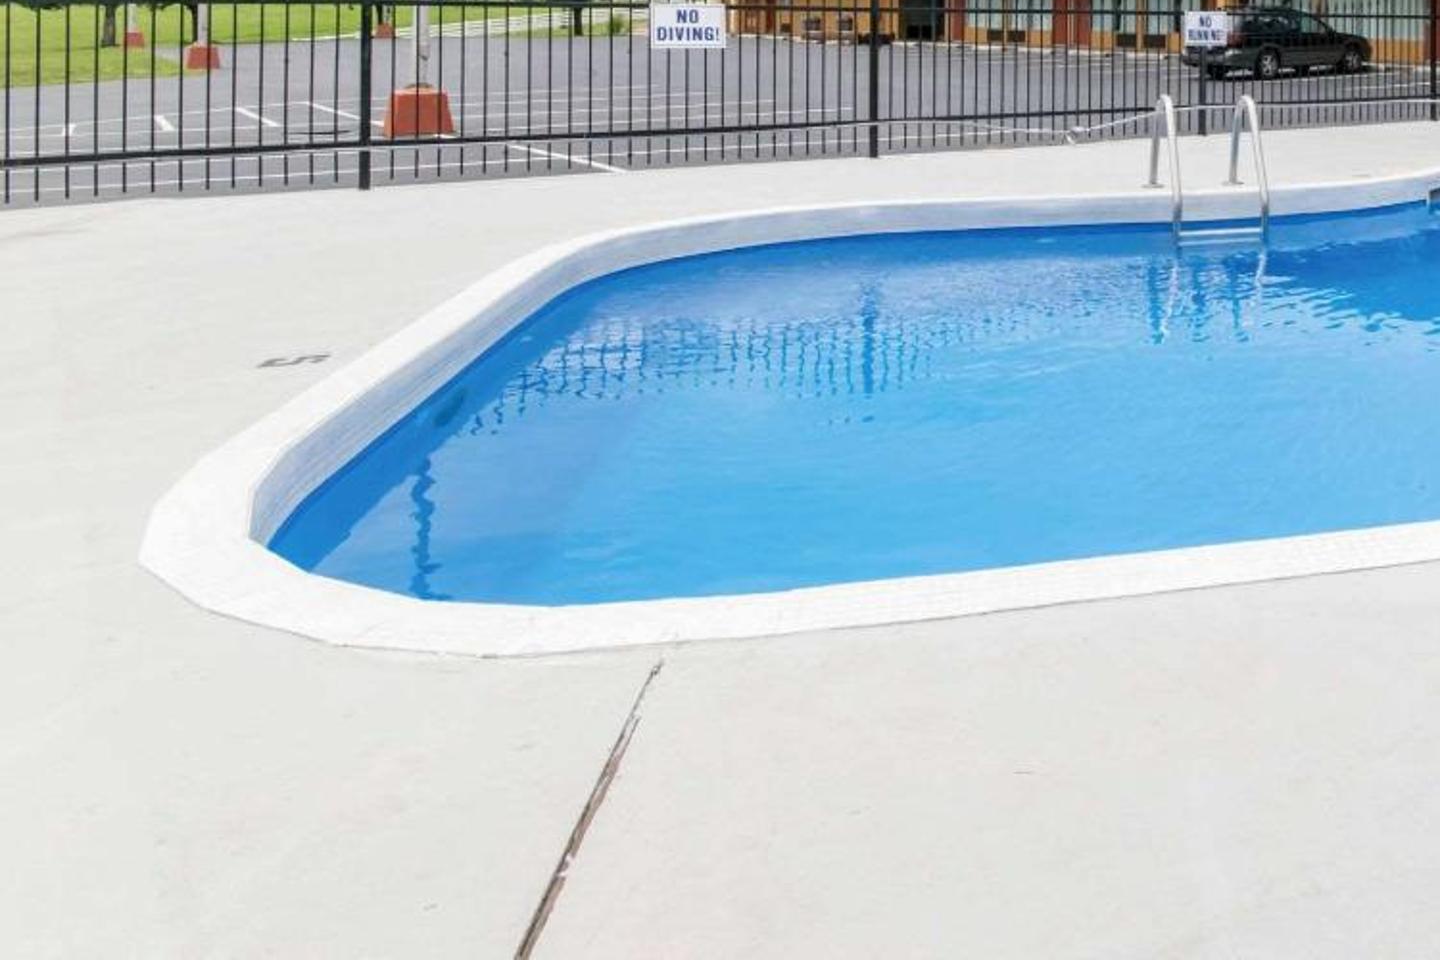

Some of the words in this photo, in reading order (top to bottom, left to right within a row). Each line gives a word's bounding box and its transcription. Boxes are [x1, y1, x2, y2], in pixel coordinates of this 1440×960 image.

[676, 9, 699, 23] NO
[1199, 16, 1212, 28] NO
[657, 26, 720, 41] DIVING!
